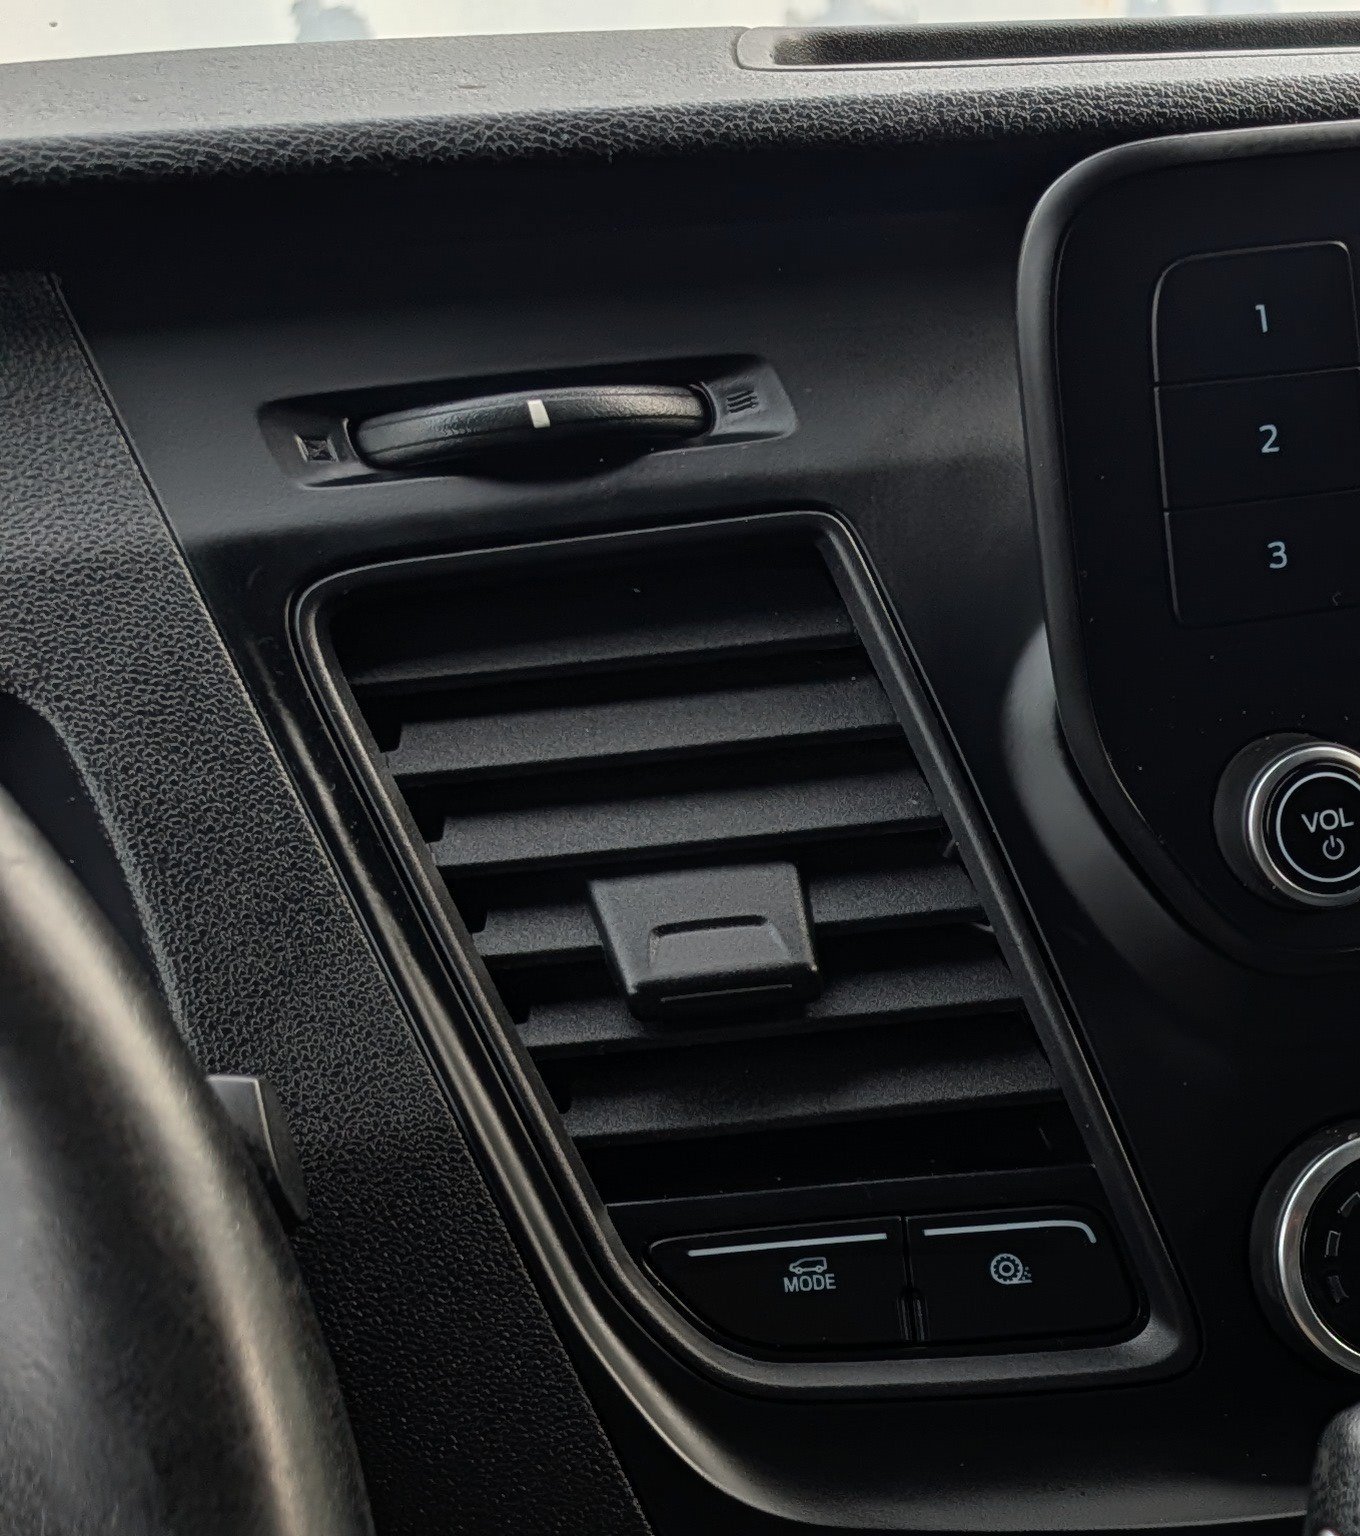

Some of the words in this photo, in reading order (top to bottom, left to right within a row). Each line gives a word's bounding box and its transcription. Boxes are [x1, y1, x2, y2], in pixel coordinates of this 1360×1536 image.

[1255, 304, 1268, 333] 1
[1259, 424, 1280, 453] 2
[1267, 541, 1288, 570] 3
[1301, 807, 1355, 834] VOL
[783, 1272, 837, 1293] MODE
